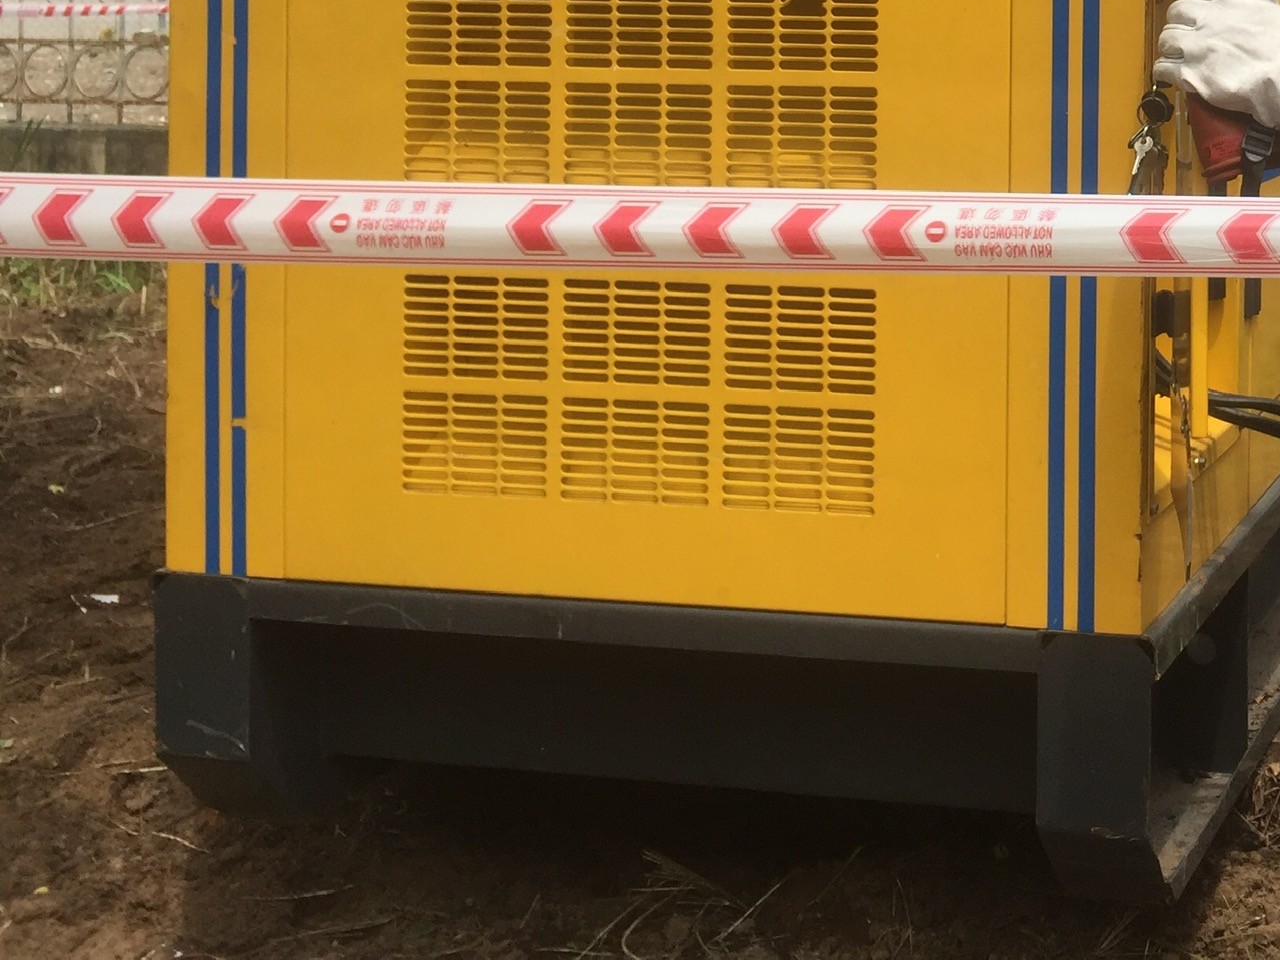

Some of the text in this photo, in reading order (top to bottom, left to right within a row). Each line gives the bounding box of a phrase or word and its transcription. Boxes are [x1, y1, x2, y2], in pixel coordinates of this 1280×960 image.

[428, 219, 448, 231] NOT
[955, 226, 1053, 238] NOT ALLOWED AREA
[1031, 244, 1053, 257] KHU
